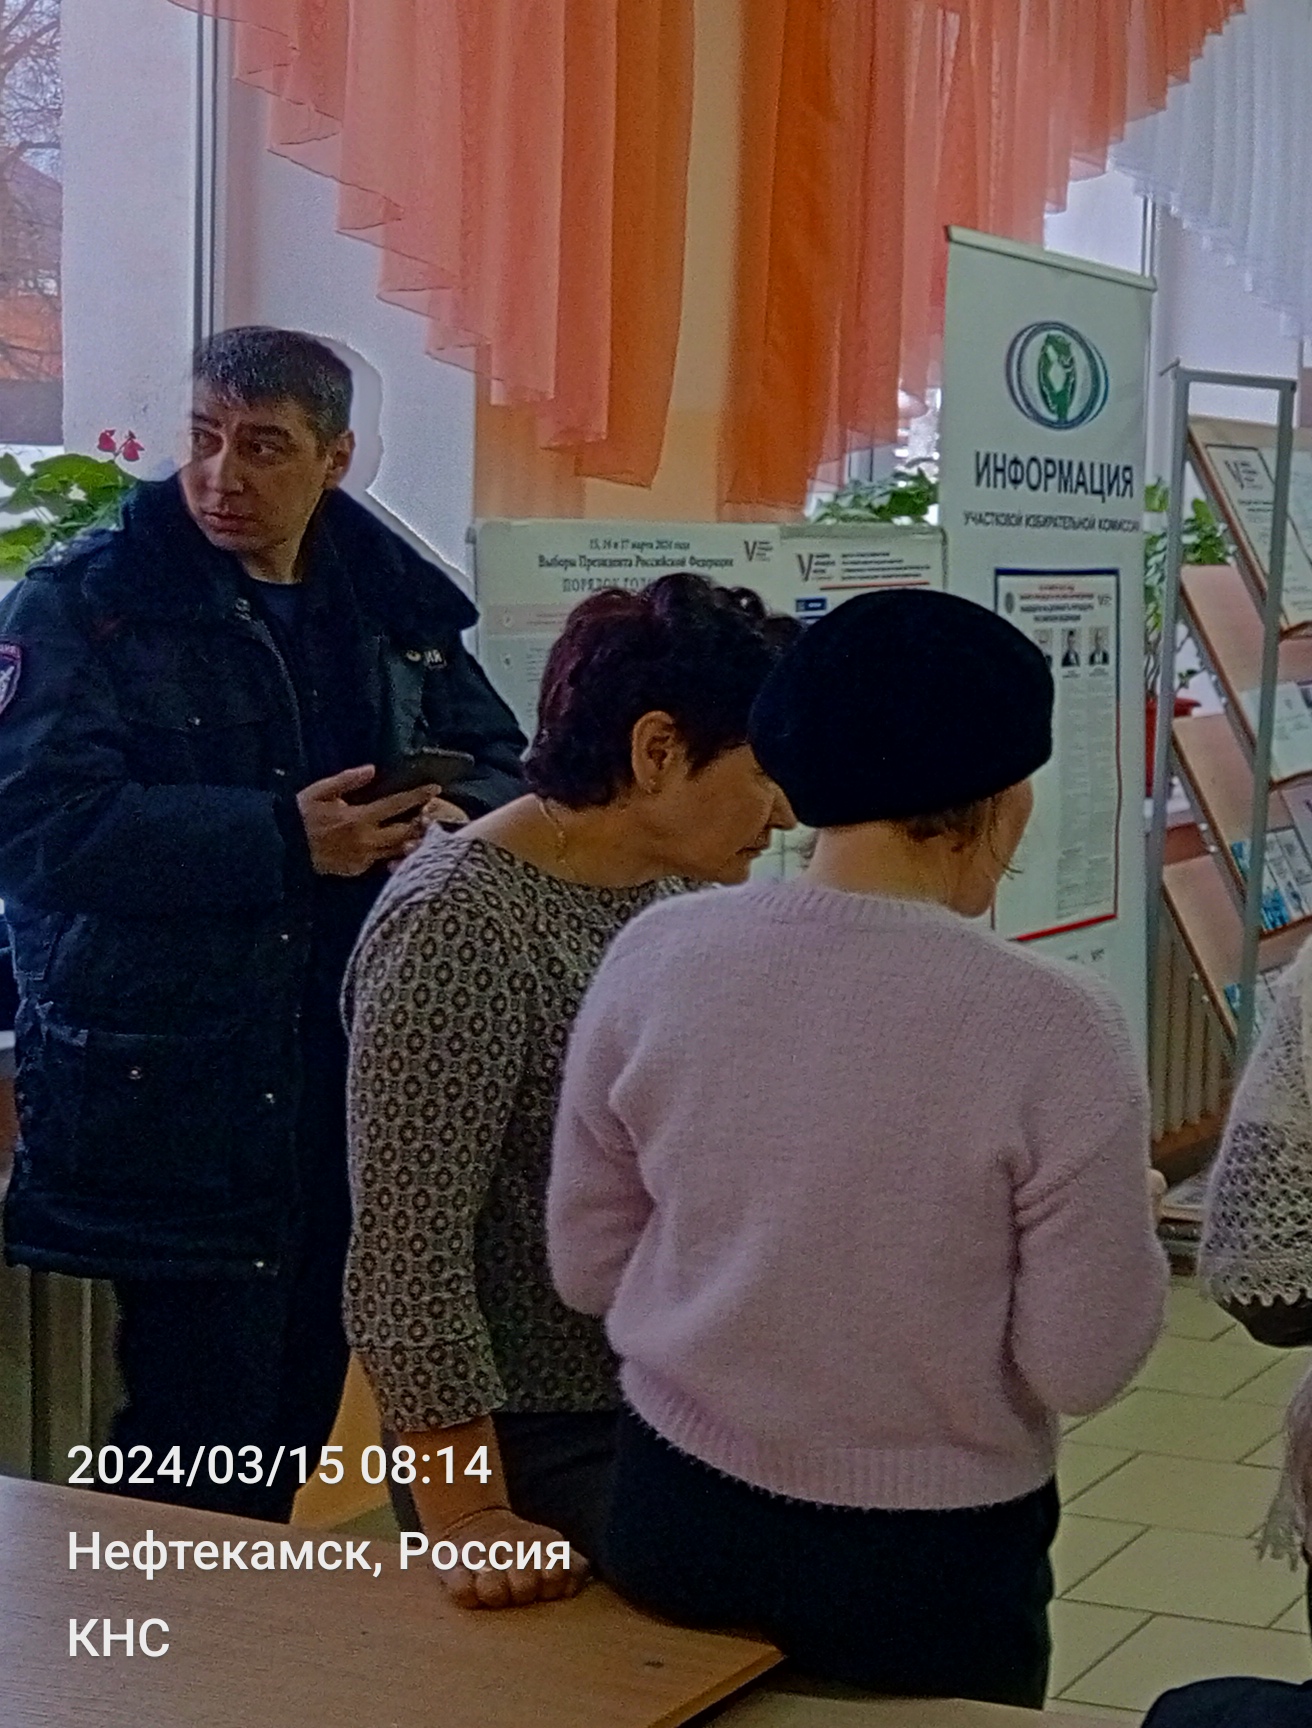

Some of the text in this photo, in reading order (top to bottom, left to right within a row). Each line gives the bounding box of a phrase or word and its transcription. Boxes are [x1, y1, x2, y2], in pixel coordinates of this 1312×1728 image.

[975, 451, 1134, 504] ИНФОРМАЦИЯ
[963, 510, 1023, 527] УЧАСТКОВОЙ
[1024, 513, 1096, 532] ИЗБИРАТЕЛЬНОЙ
[538, 554, 734, 571] Выборы Президента Российской Федерации
